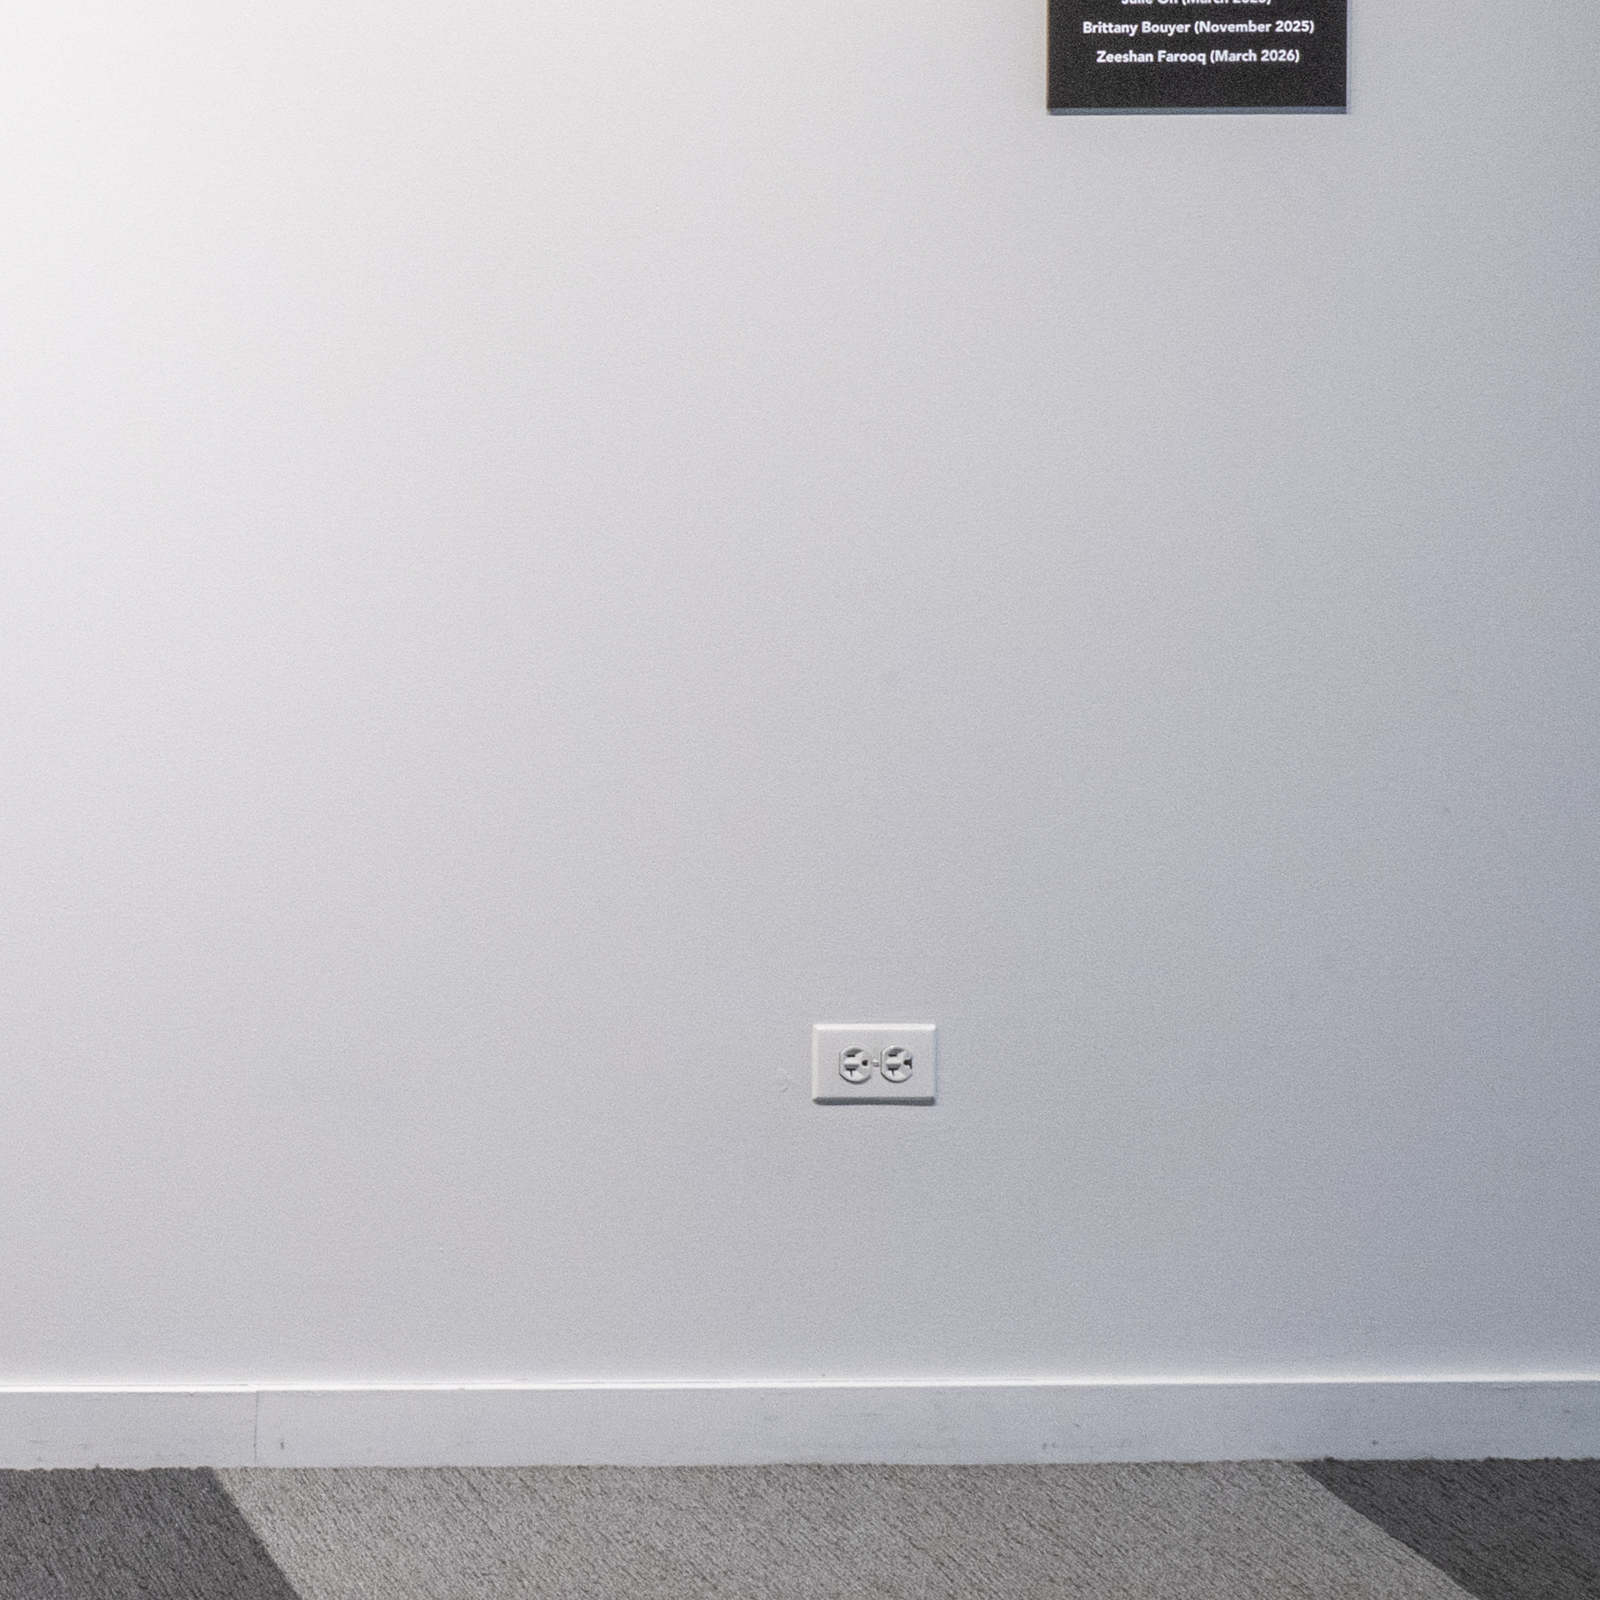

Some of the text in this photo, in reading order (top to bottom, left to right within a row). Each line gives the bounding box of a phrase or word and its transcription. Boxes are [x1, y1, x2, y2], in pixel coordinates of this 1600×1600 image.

[1082, 19, 1315, 37] Brittany Bouyer (November 2025)
[1096, 48, 1301, 66] Zeeshan Farooq (March 2026)
